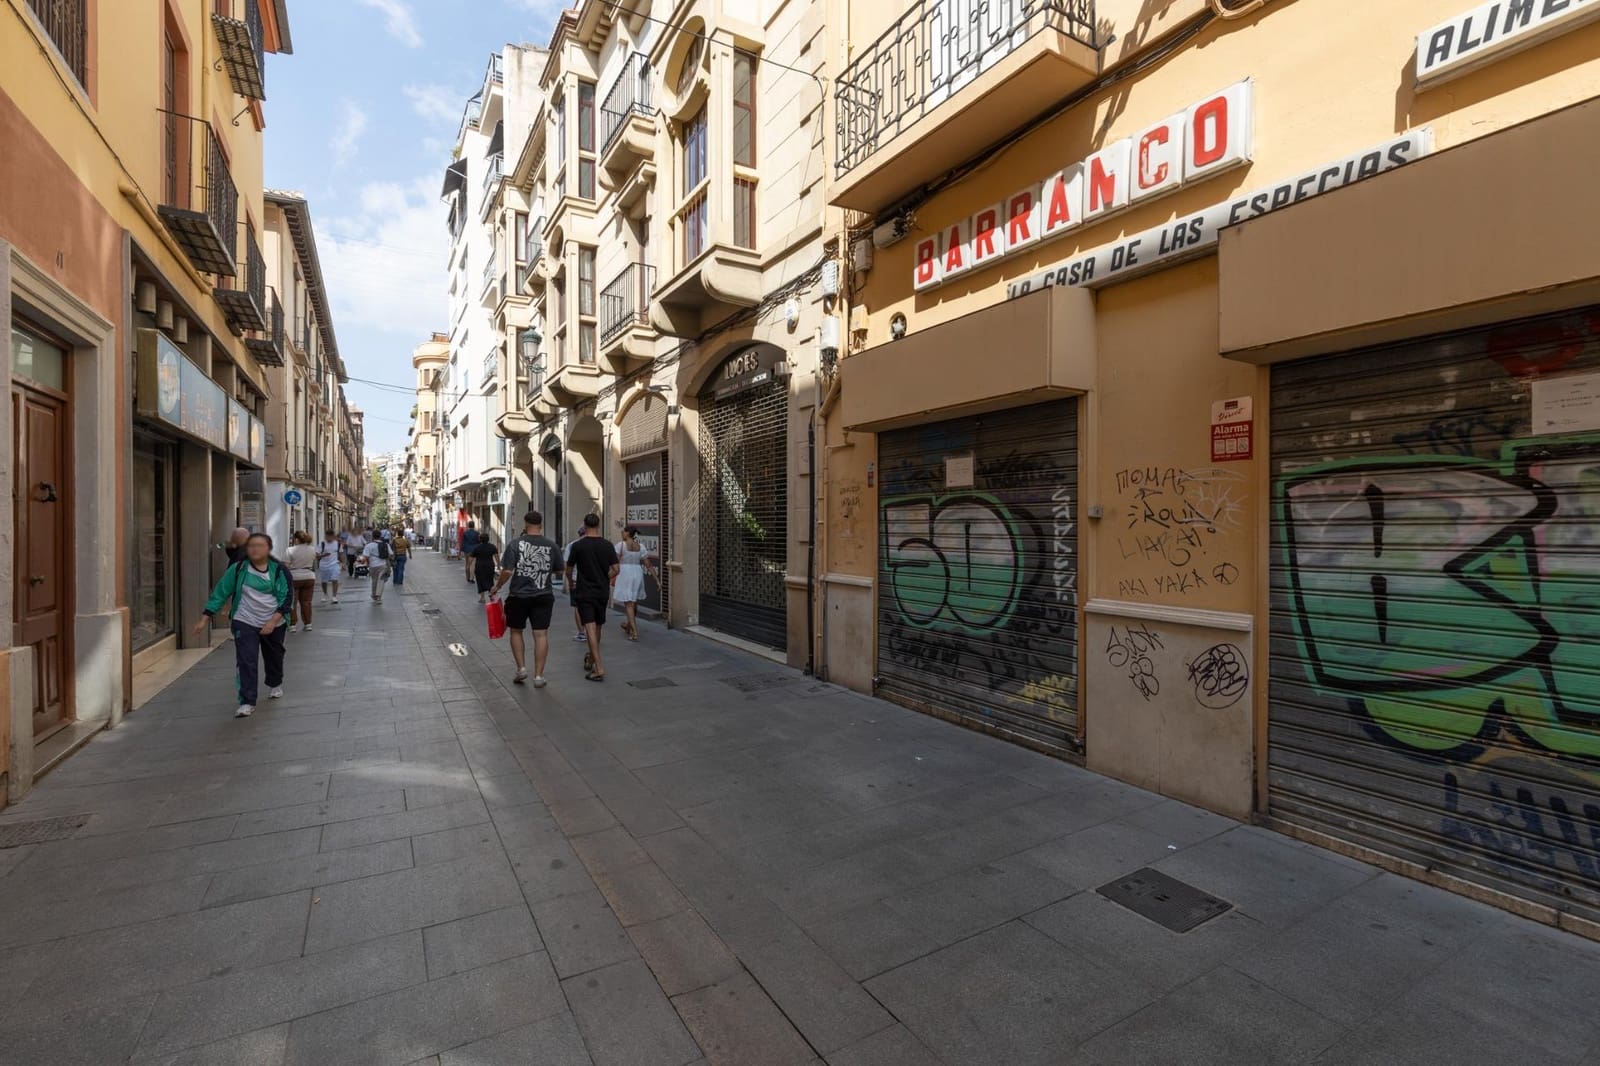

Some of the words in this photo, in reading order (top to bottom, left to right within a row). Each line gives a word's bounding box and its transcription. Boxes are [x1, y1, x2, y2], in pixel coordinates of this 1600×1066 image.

[916, 95, 1228, 284] BARRANCO
[1043, 256, 1096, 287] CASA
[1110, 239, 1142, 271] DE
[1158, 216, 1204, 256] LAS
[1229, 140, 1411, 224] ESPECIAS
[724, 352, 759, 380] LUCES
[1213, 424, 1249, 435] Alarma
[629, 471, 657, 489] HOMIX
